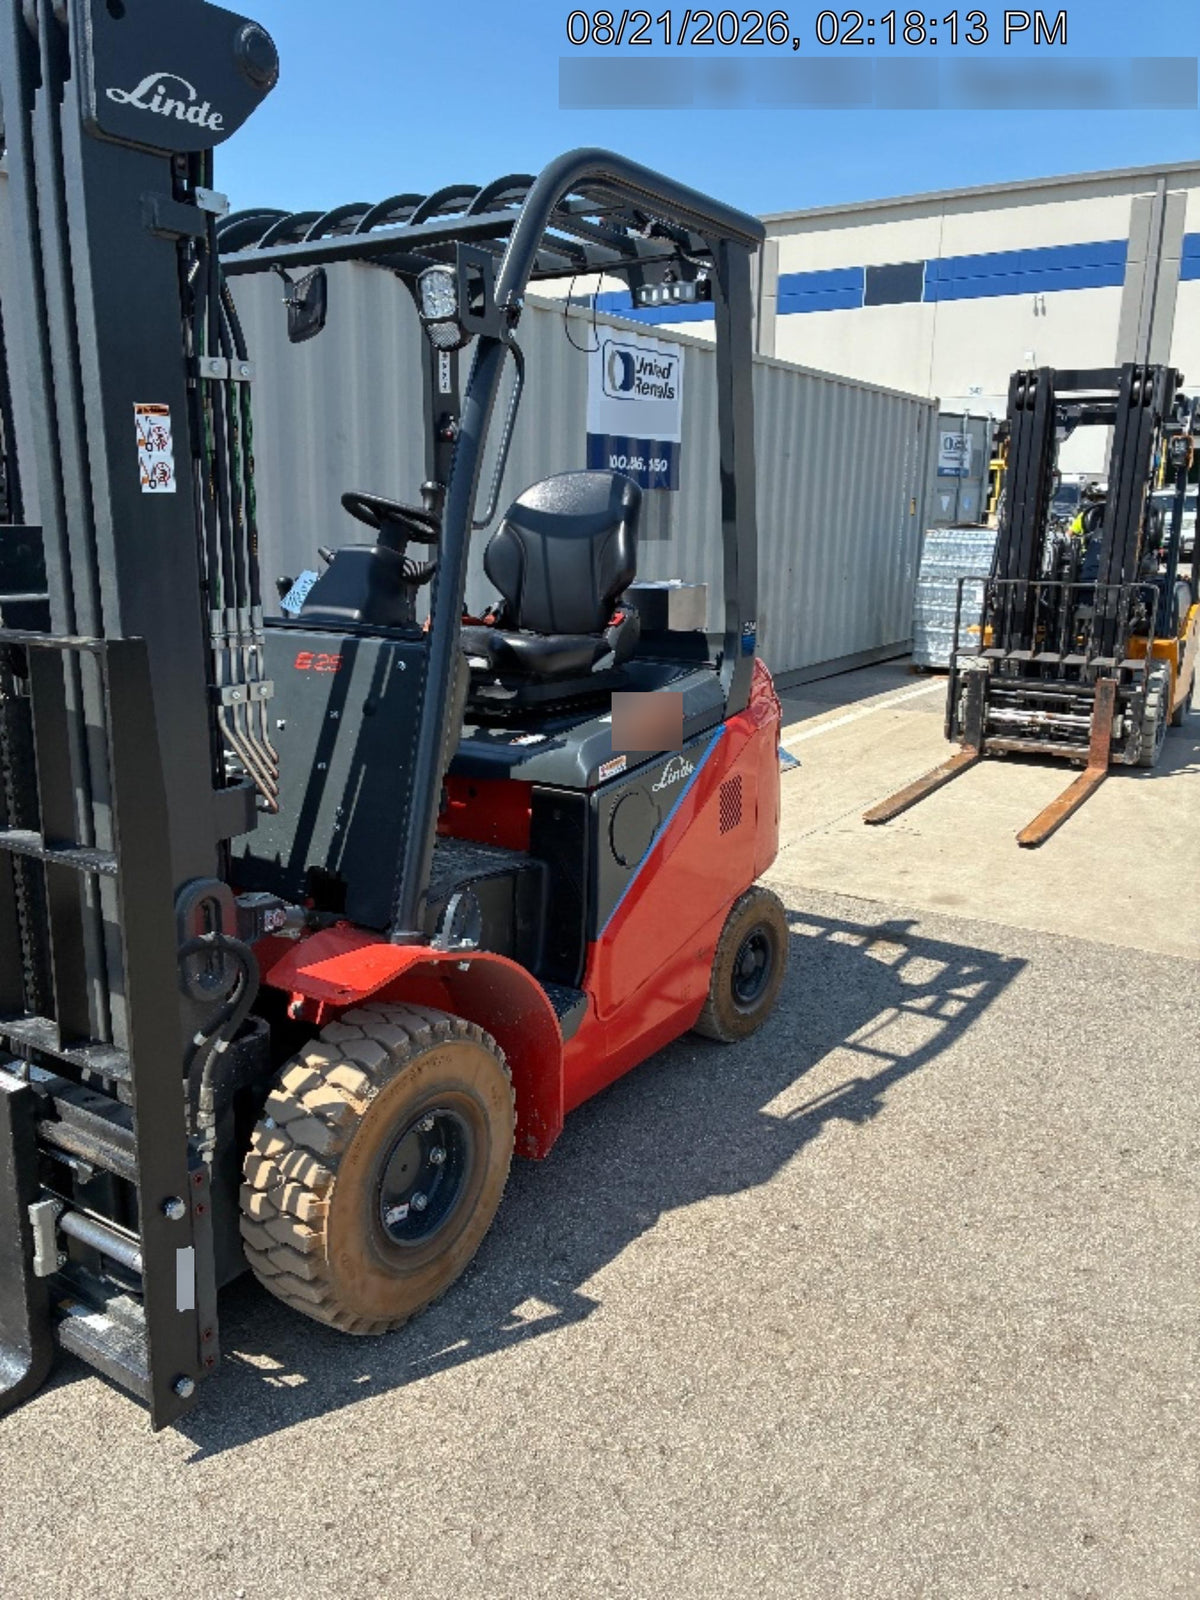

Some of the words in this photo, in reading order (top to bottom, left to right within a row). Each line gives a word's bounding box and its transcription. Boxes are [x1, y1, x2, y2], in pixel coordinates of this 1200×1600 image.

[105, 72, 225, 129] Linde
[635, 355, 674, 379] Unied
[635, 376, 675, 400] Renals
